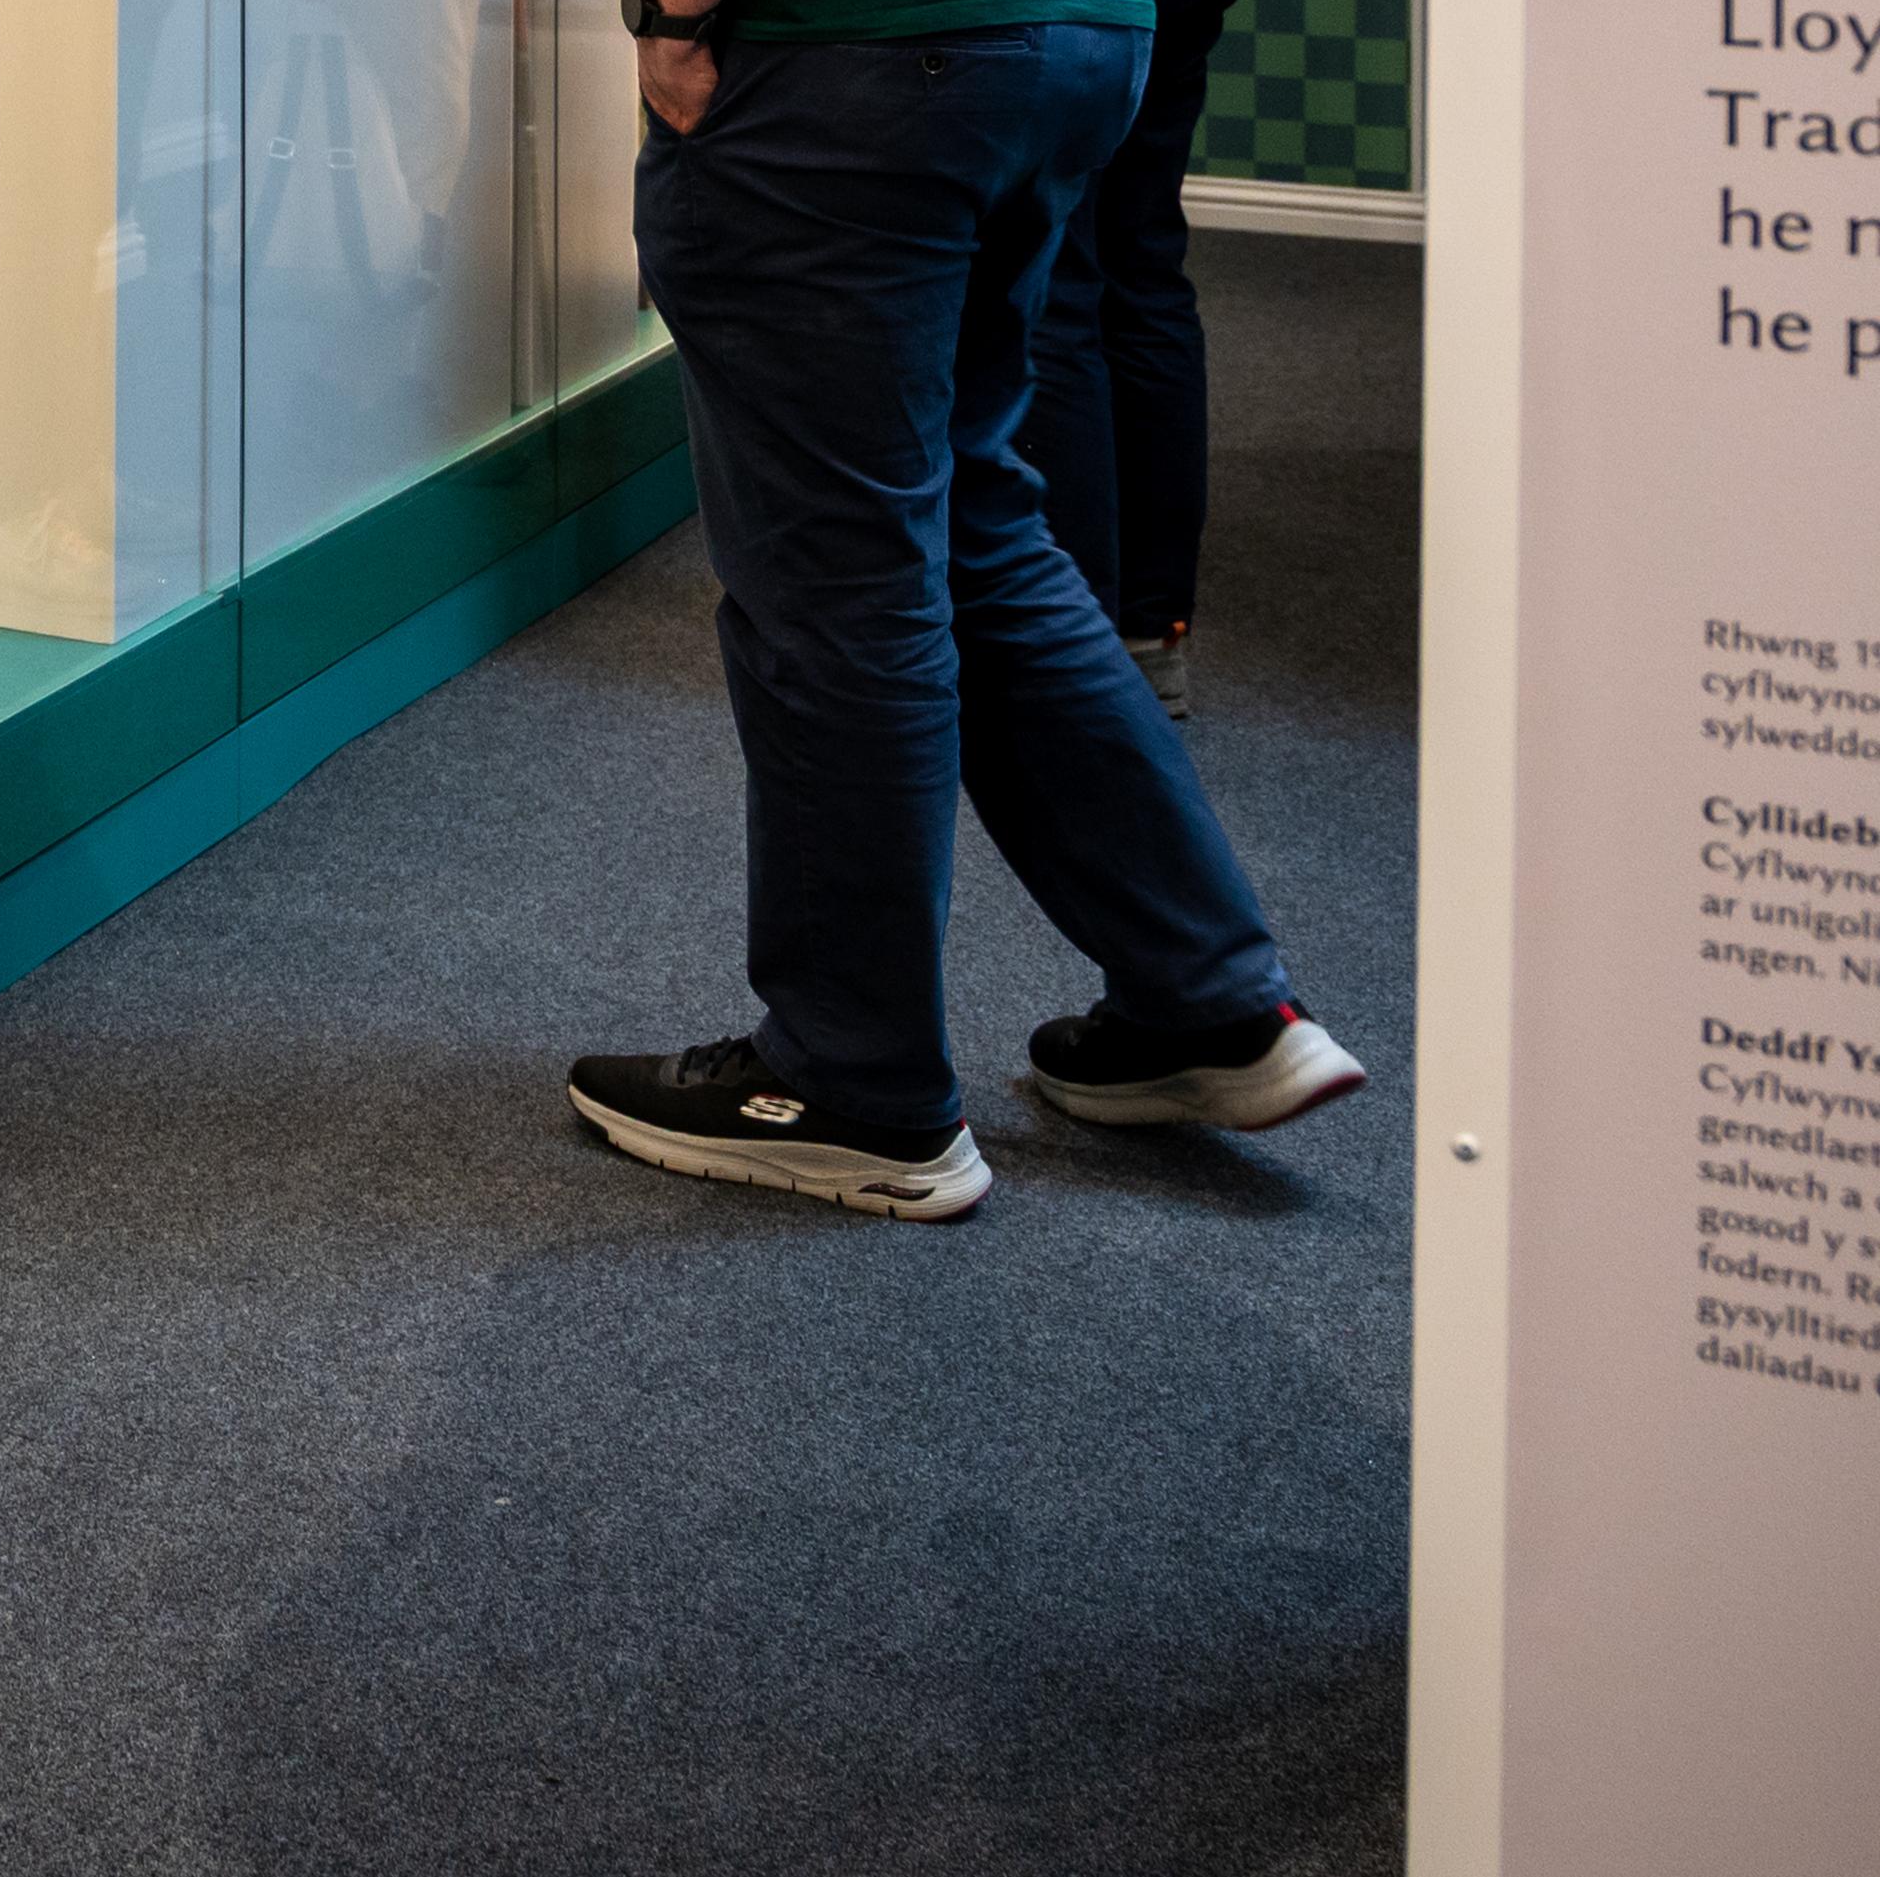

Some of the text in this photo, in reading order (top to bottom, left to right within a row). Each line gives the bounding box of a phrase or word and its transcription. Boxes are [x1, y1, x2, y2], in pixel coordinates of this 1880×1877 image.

[1718, 184, 1814, 255] he
[1717, 284, 1814, 355] he
[1703, 617, 1840, 673] Rhwng
[1698, 892, 1739, 919] ar
[1699, 1015, 1835, 1067] Deddf
[1697, 1158, 1864, 1212] salwch a
[1696, 1205, 1846, 1260] gosod y
[1695, 1334, 1863, 1395] daliadau
